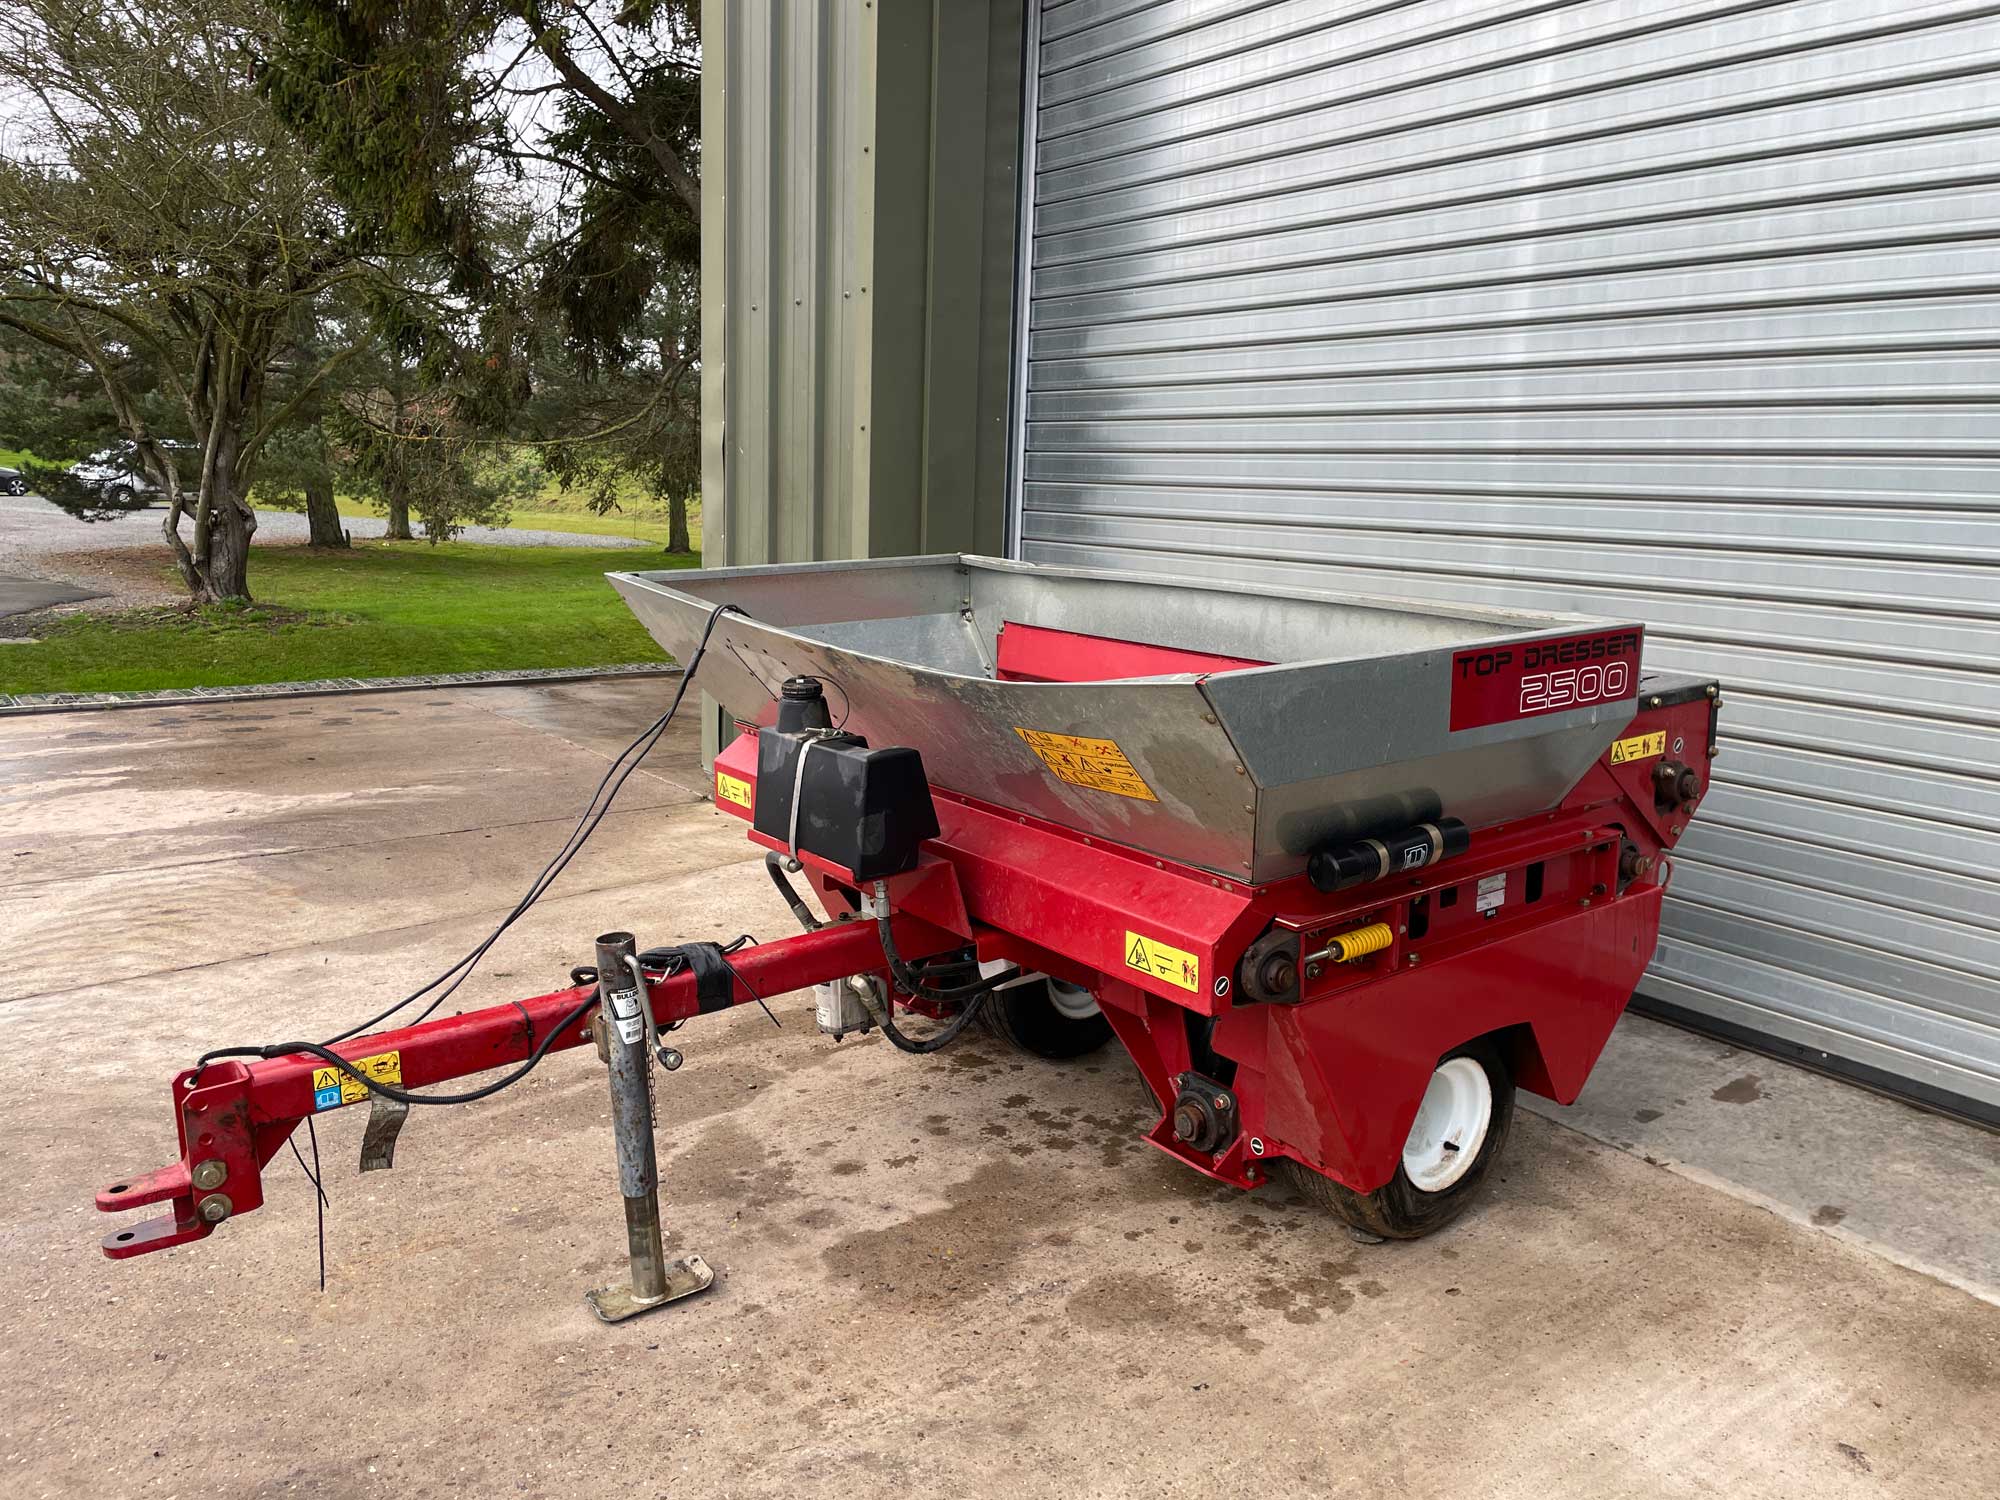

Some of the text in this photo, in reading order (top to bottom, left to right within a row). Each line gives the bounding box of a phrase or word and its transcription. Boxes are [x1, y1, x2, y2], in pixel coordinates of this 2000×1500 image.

[1457, 633, 1638, 679] TOP DRESSER
[1519, 662, 1629, 713] 2500
